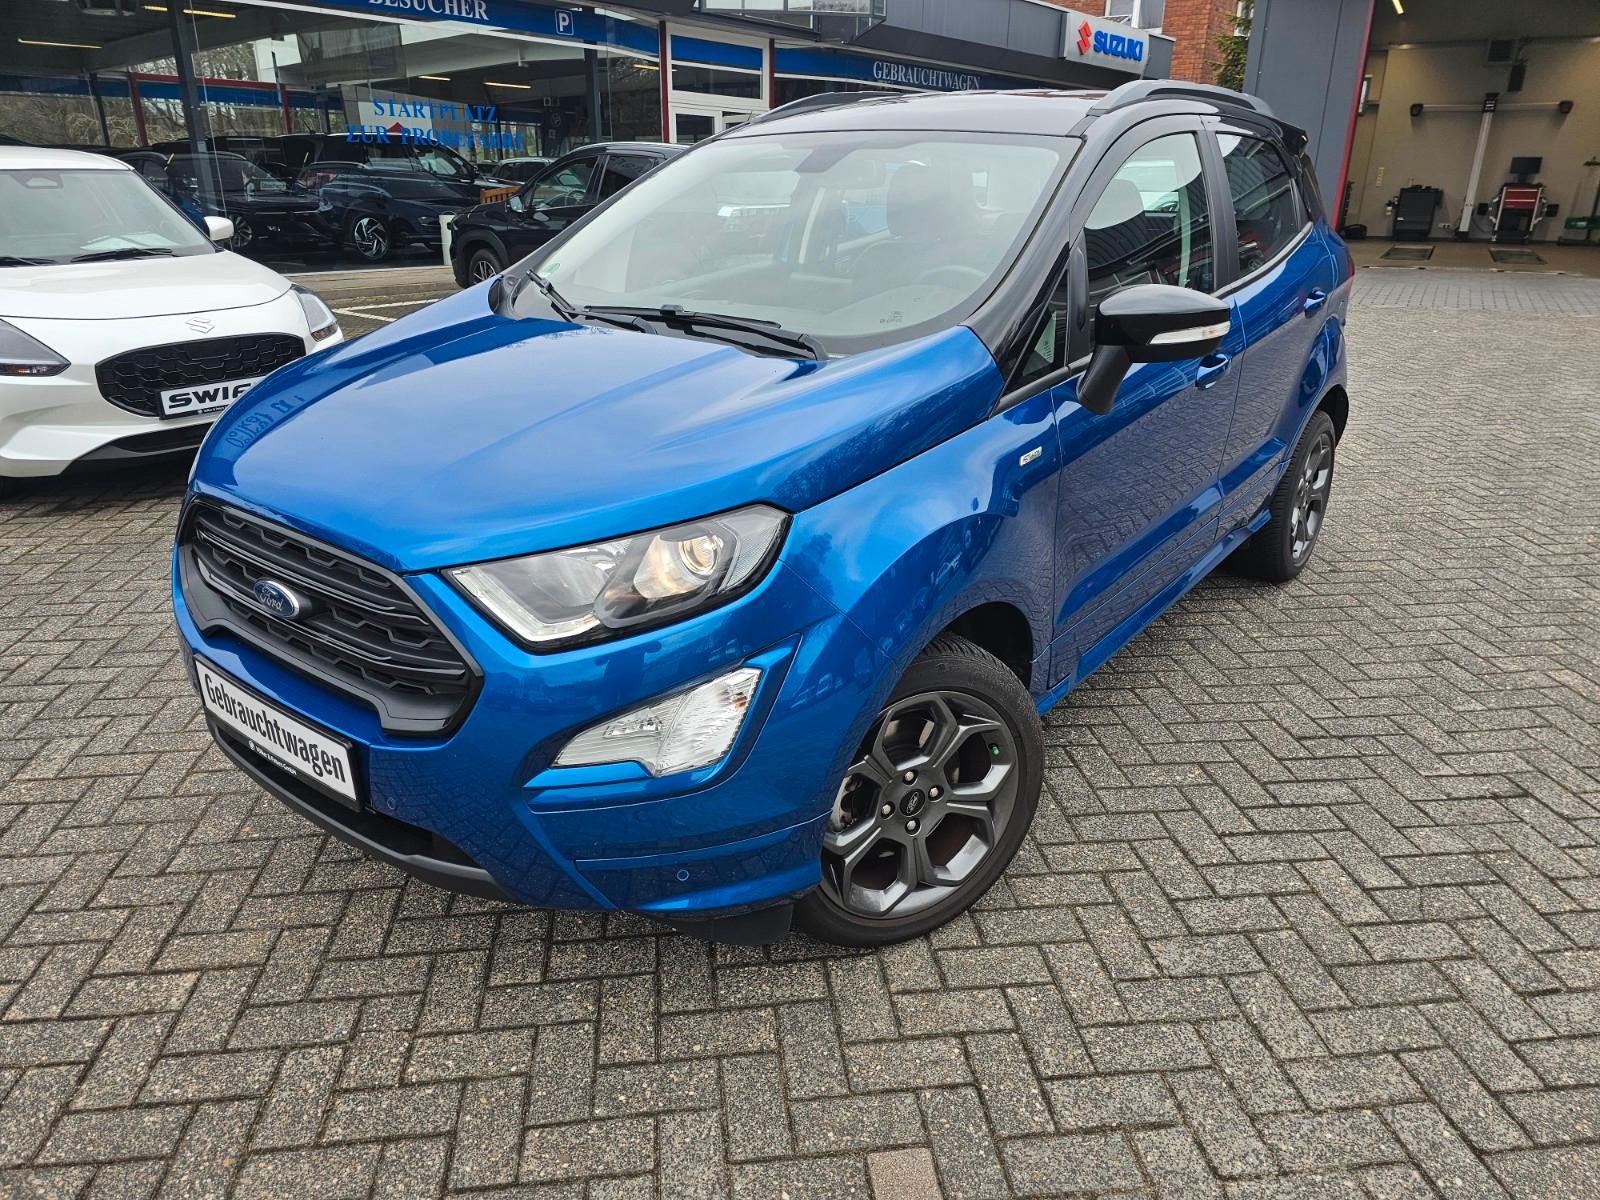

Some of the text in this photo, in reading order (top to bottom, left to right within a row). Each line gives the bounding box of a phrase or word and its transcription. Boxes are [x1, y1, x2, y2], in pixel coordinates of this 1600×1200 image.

[368, 0, 489, 20] SUCHER
[559, 12, 570, 32] P
[1093, 30, 1144, 62] SUZUKI
[872, 60, 982, 90] GEBRAUCHTWAGEN
[373, 98, 498, 124] STARTPLATZ
[346, 124, 391, 145] ZUR
[259, 585, 285, 611] Ford
[204, 673, 346, 783] Gebrauchtwagen
